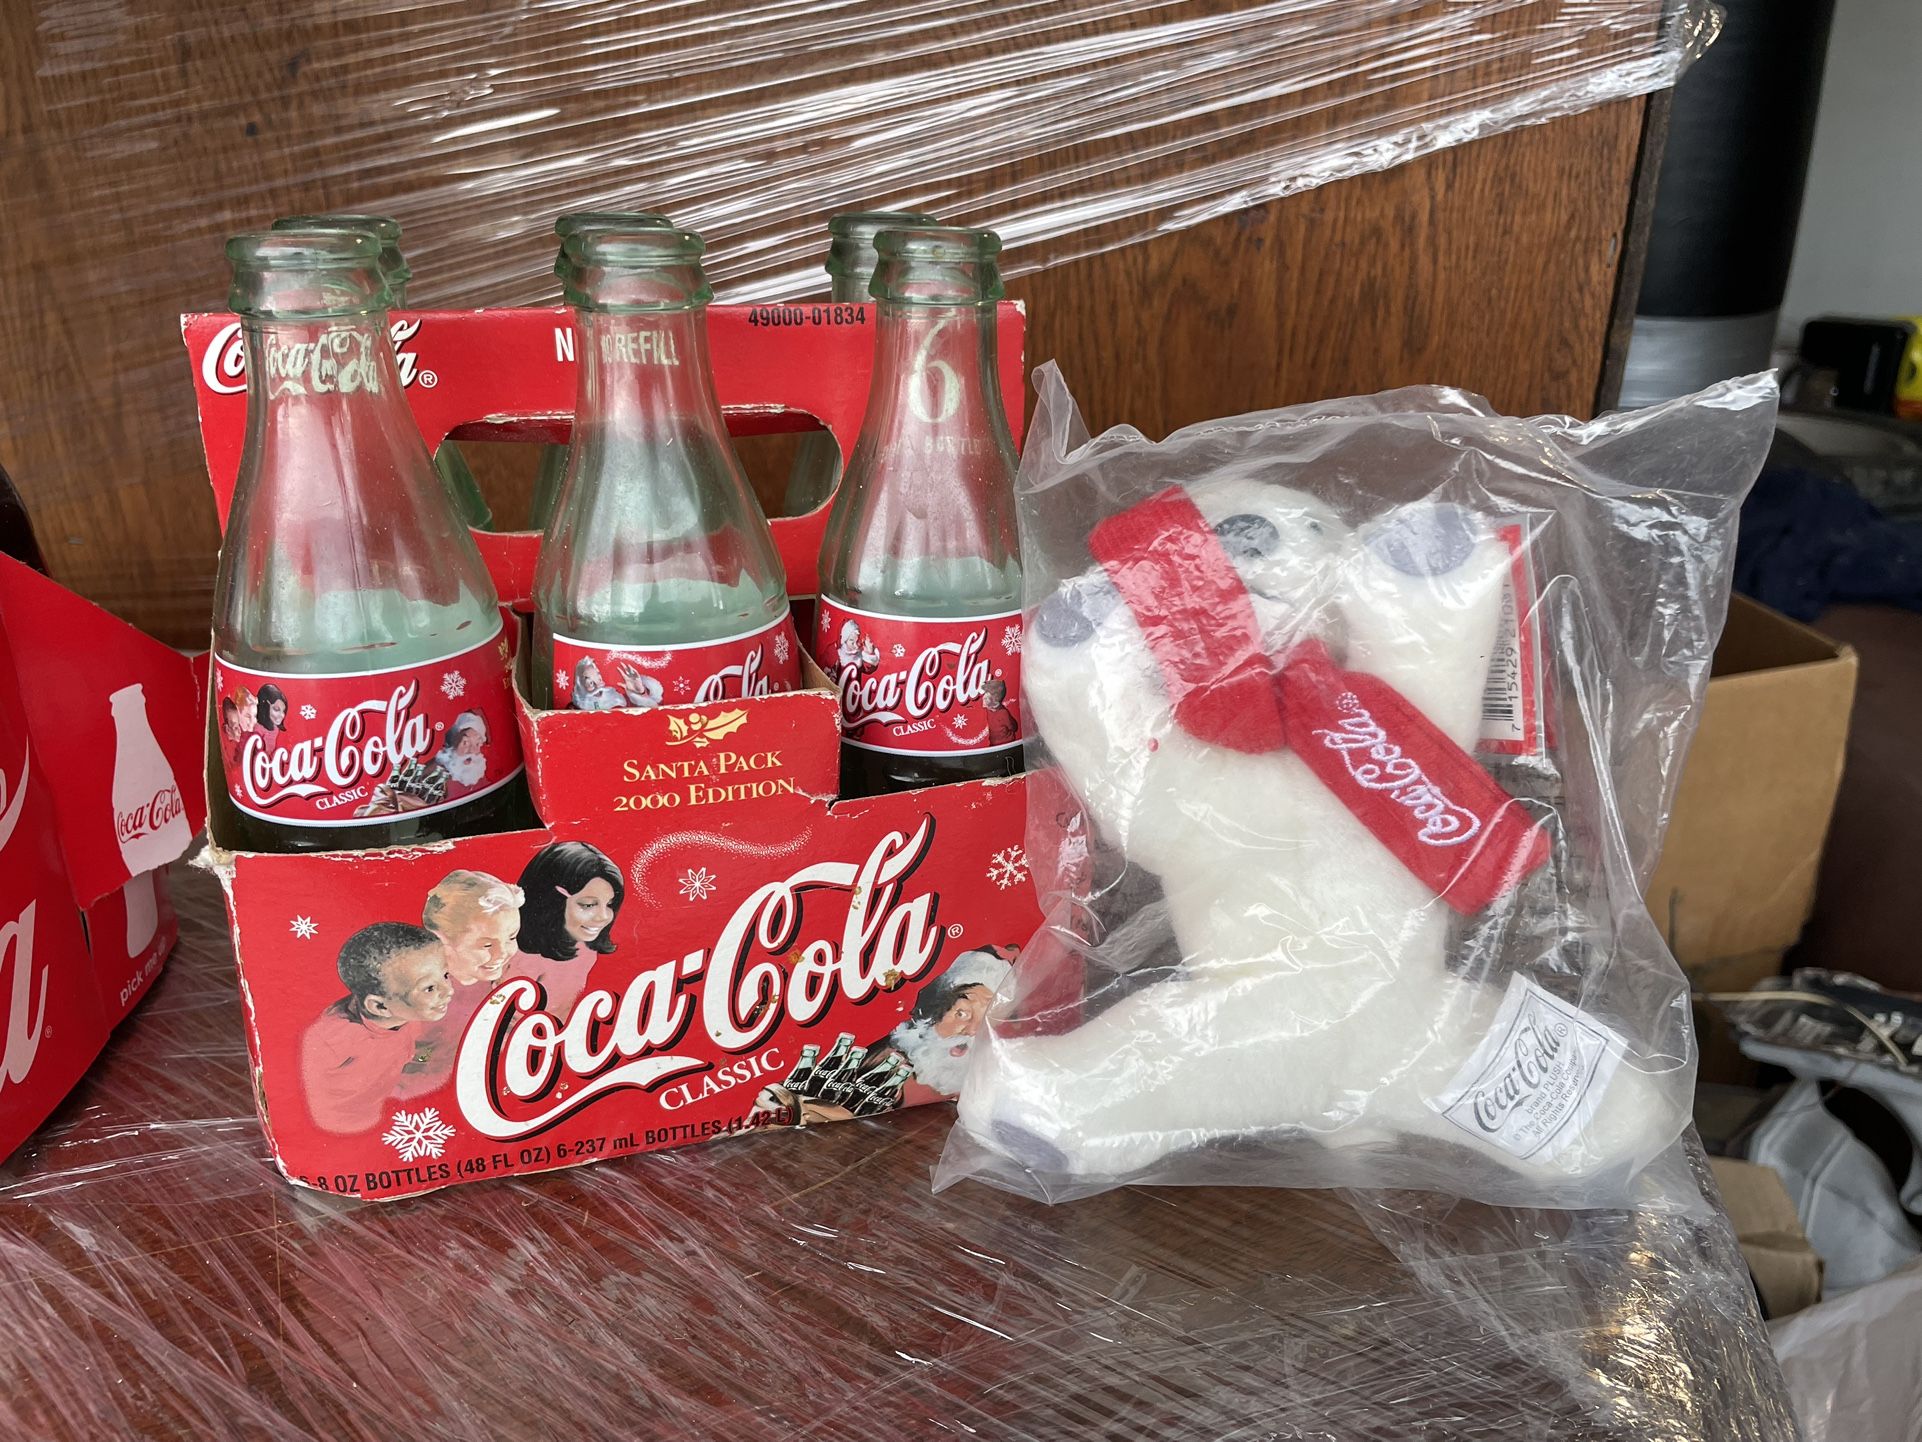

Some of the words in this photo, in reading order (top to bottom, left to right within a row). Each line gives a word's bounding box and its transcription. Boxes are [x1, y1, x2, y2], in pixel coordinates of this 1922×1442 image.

[748, 305, 867, 328] 49000-01834
[906, 308, 961, 424] 6
[1506, 646, 1519, 702] 15429
[242, 678, 431, 807] Coca-Cola
[892, 717, 937, 738] CLASSIC
[612, 790, 681, 813] 2000
[687, 776, 796, 807] EDITION
[622, 757, 710, 783] SANTA
[718, 750, 784, 773] PACK
[116, 785, 181, 844] Coca-Cola
[315, 785, 369, 811] CLASSIC
[119, 970, 144, 1008] pick
[456, 812, 940, 1139] Coca-Cola
[658, 1046, 785, 1112] CLASSIC
[1472, 1010, 1562, 1133] Coca-Cola
[334, 1174, 360, 1193] OZ
[365, 1162, 451, 1192] BOTTLES
[456, 1156, 487, 1179] (48
[492, 1152, 514, 1170] FL
[519, 1146, 551, 1165] OZ)
[556, 1136, 607, 1159] 6-237
[613, 1130, 641, 1150] mL
[645, 1119, 723, 1146] BOTTLES
